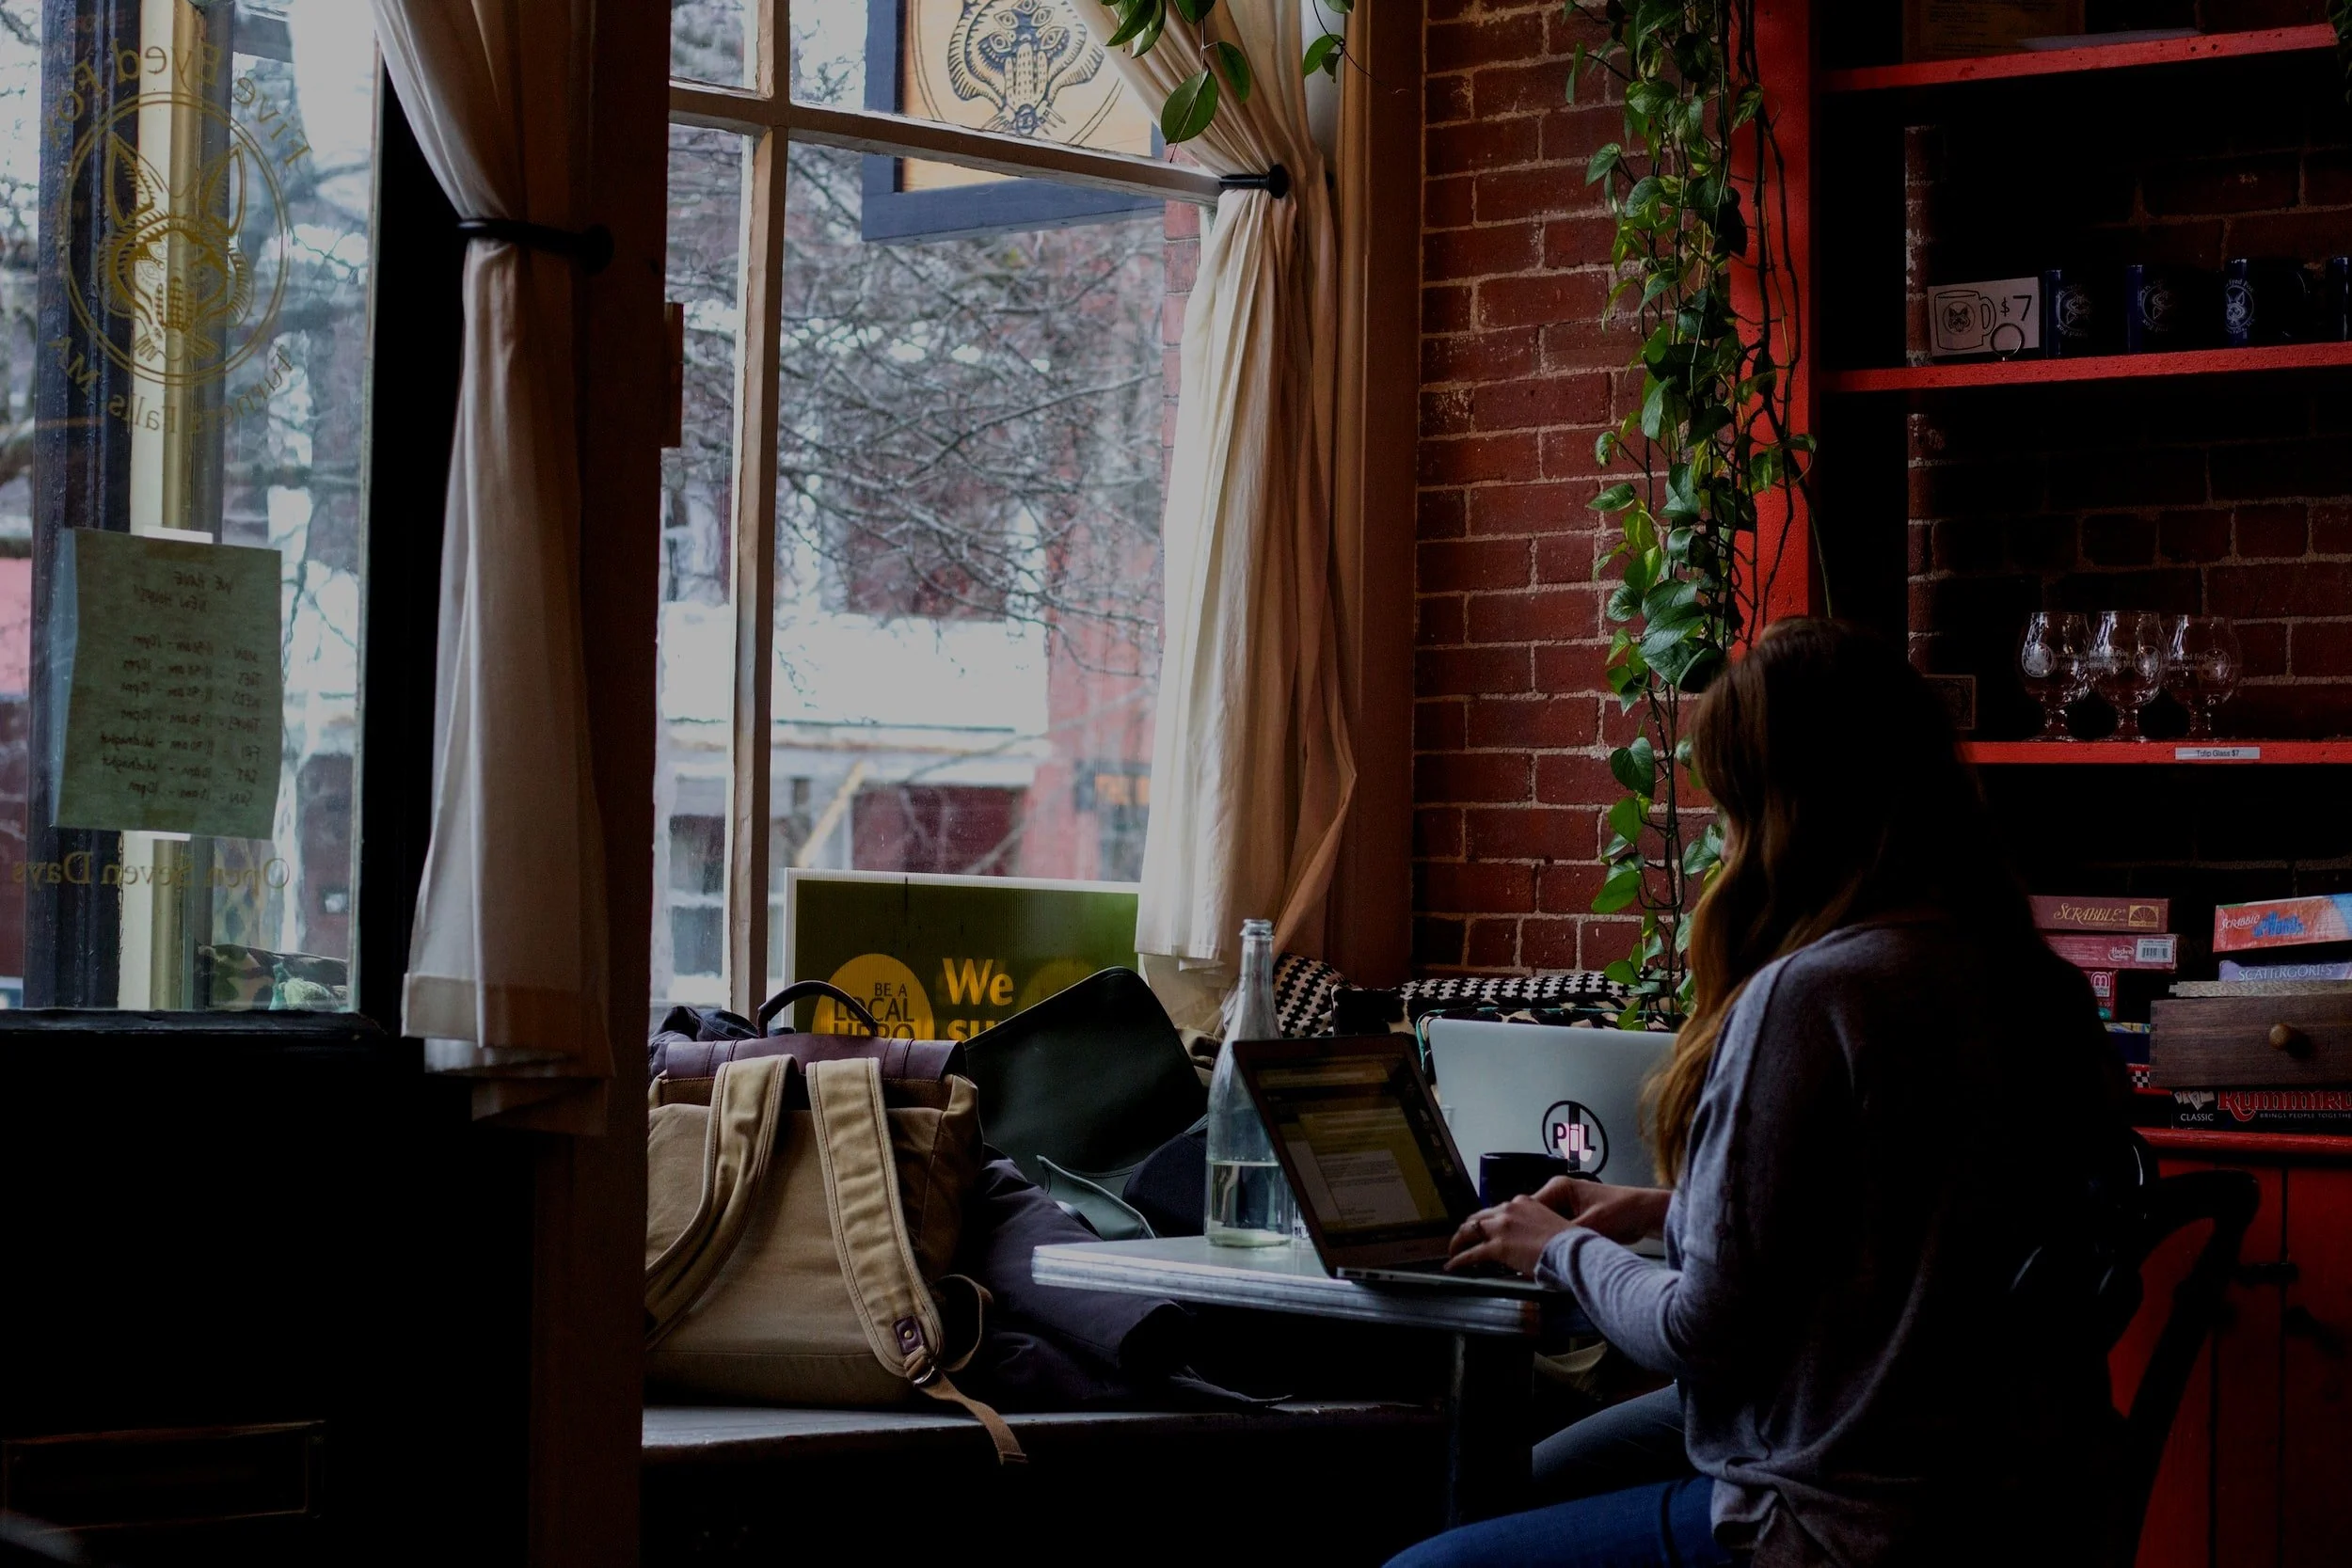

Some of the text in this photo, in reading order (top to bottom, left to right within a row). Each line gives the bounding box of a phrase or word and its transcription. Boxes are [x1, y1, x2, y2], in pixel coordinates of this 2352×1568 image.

[2000, 295, 2032, 321] $7
[2054, 903, 2122, 926] SCRABBLE
[943, 958, 1014, 1007] We
[2239, 965, 2334, 981] SCATTERGORIES
[874, 983, 908, 997] BE A
[2180, 1113, 2215, 1122] CLASSIC
